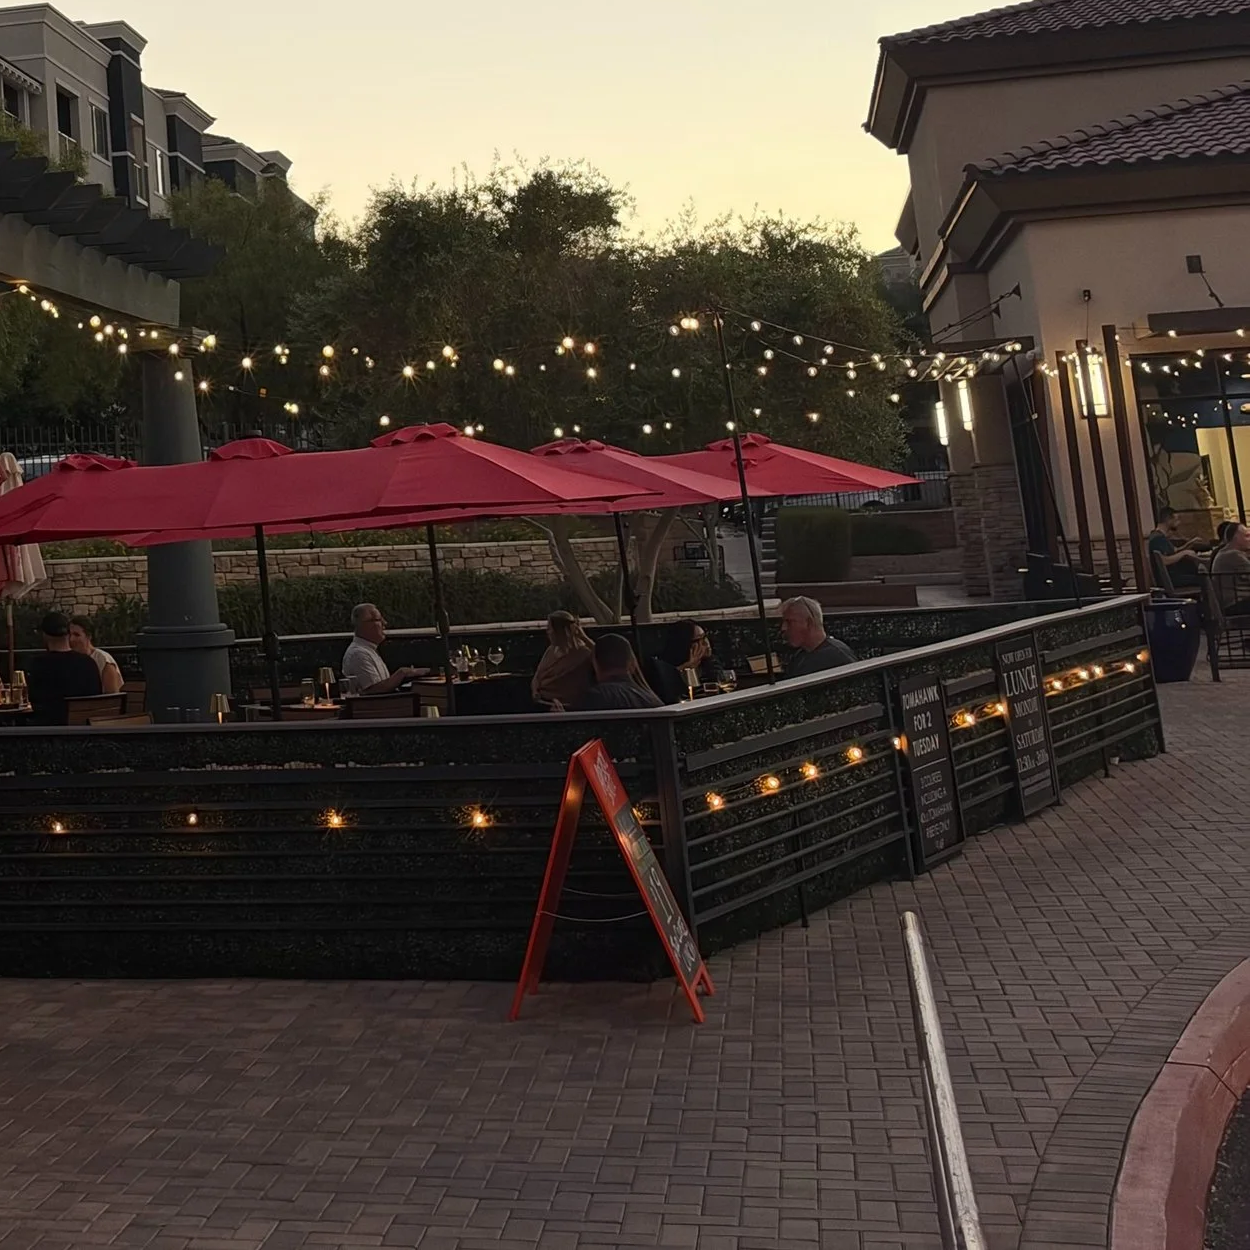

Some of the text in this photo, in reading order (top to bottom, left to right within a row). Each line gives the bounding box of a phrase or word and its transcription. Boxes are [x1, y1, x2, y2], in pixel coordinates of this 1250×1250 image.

[1003, 664, 1039, 697] LUNCH
[902, 685, 940, 710] TOMAHAWK
[913, 711, 933, 732] FOR 2
[912, 733, 940, 758] TUESDAY
